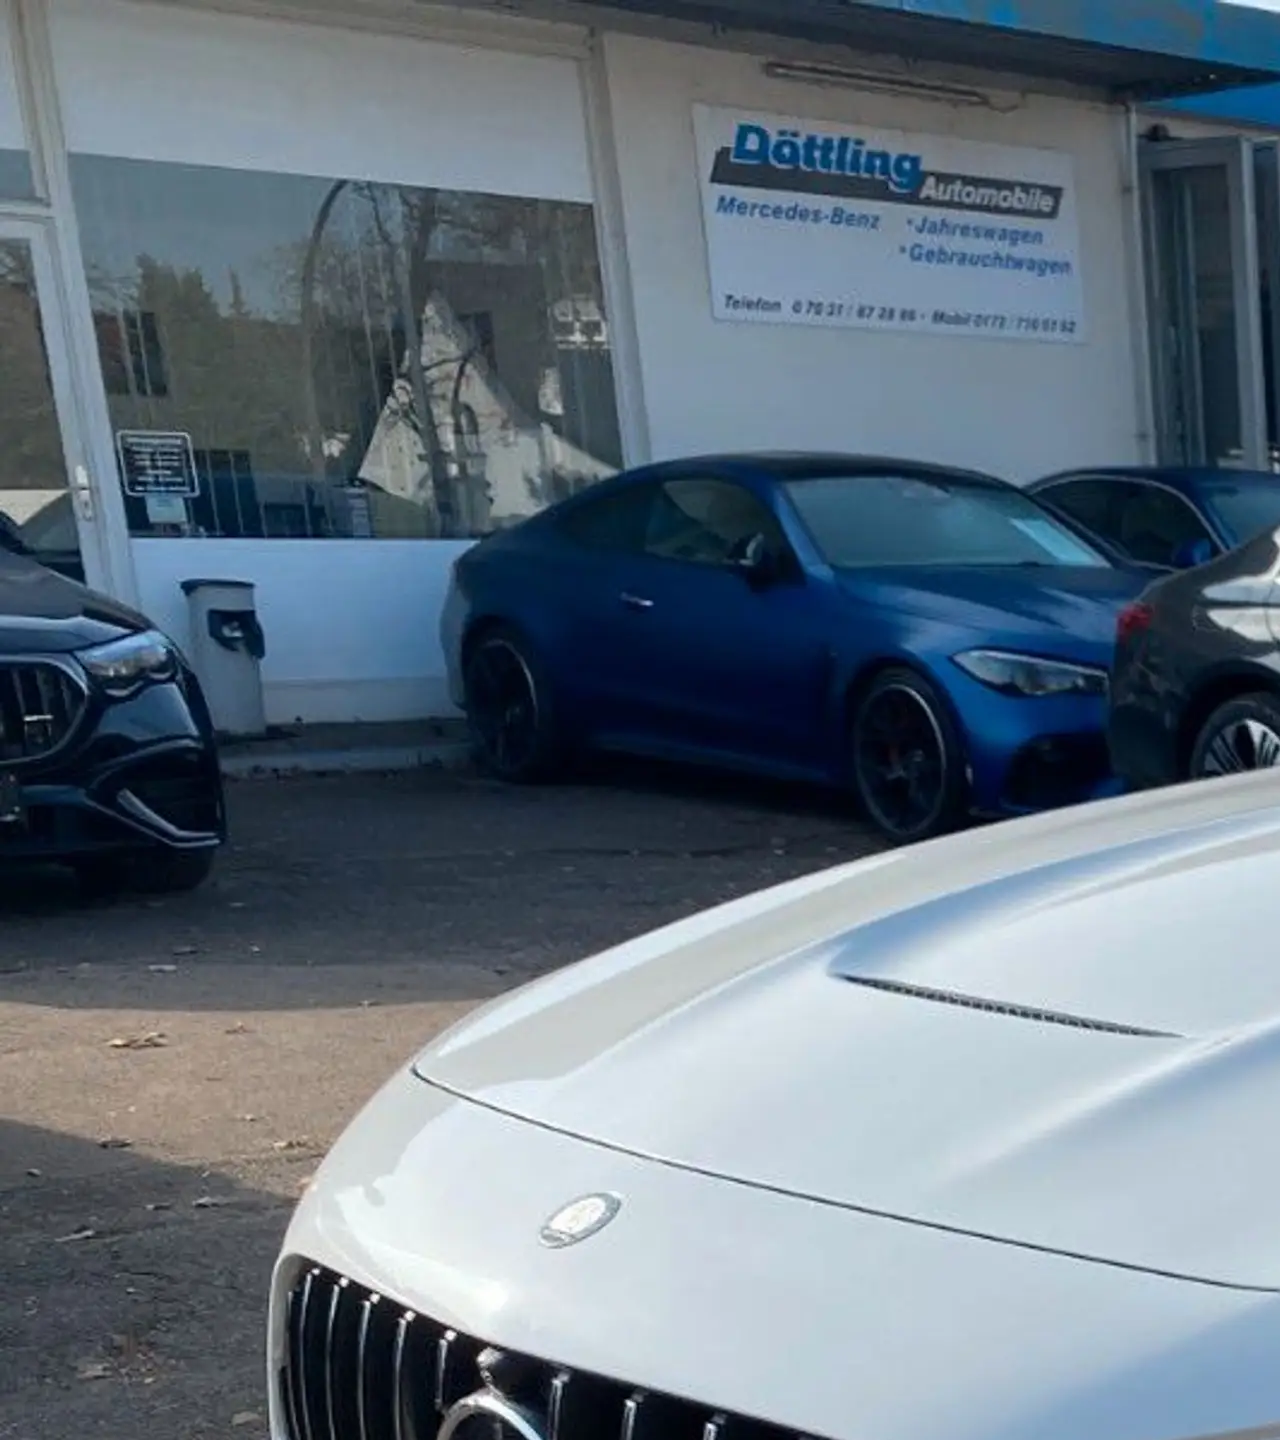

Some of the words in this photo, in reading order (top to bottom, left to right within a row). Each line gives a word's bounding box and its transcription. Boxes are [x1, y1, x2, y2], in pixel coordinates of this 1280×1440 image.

[732, 123, 922, 190] Döttling
[920, 175, 1053, 213] Automobile
[716, 195, 881, 230] Mercedes-Benz
[915, 217, 1043, 247] Jahreswagen
[909, 244, 1073, 278] Gebrauchtwagen
[725, 294, 782, 313] Telefon
